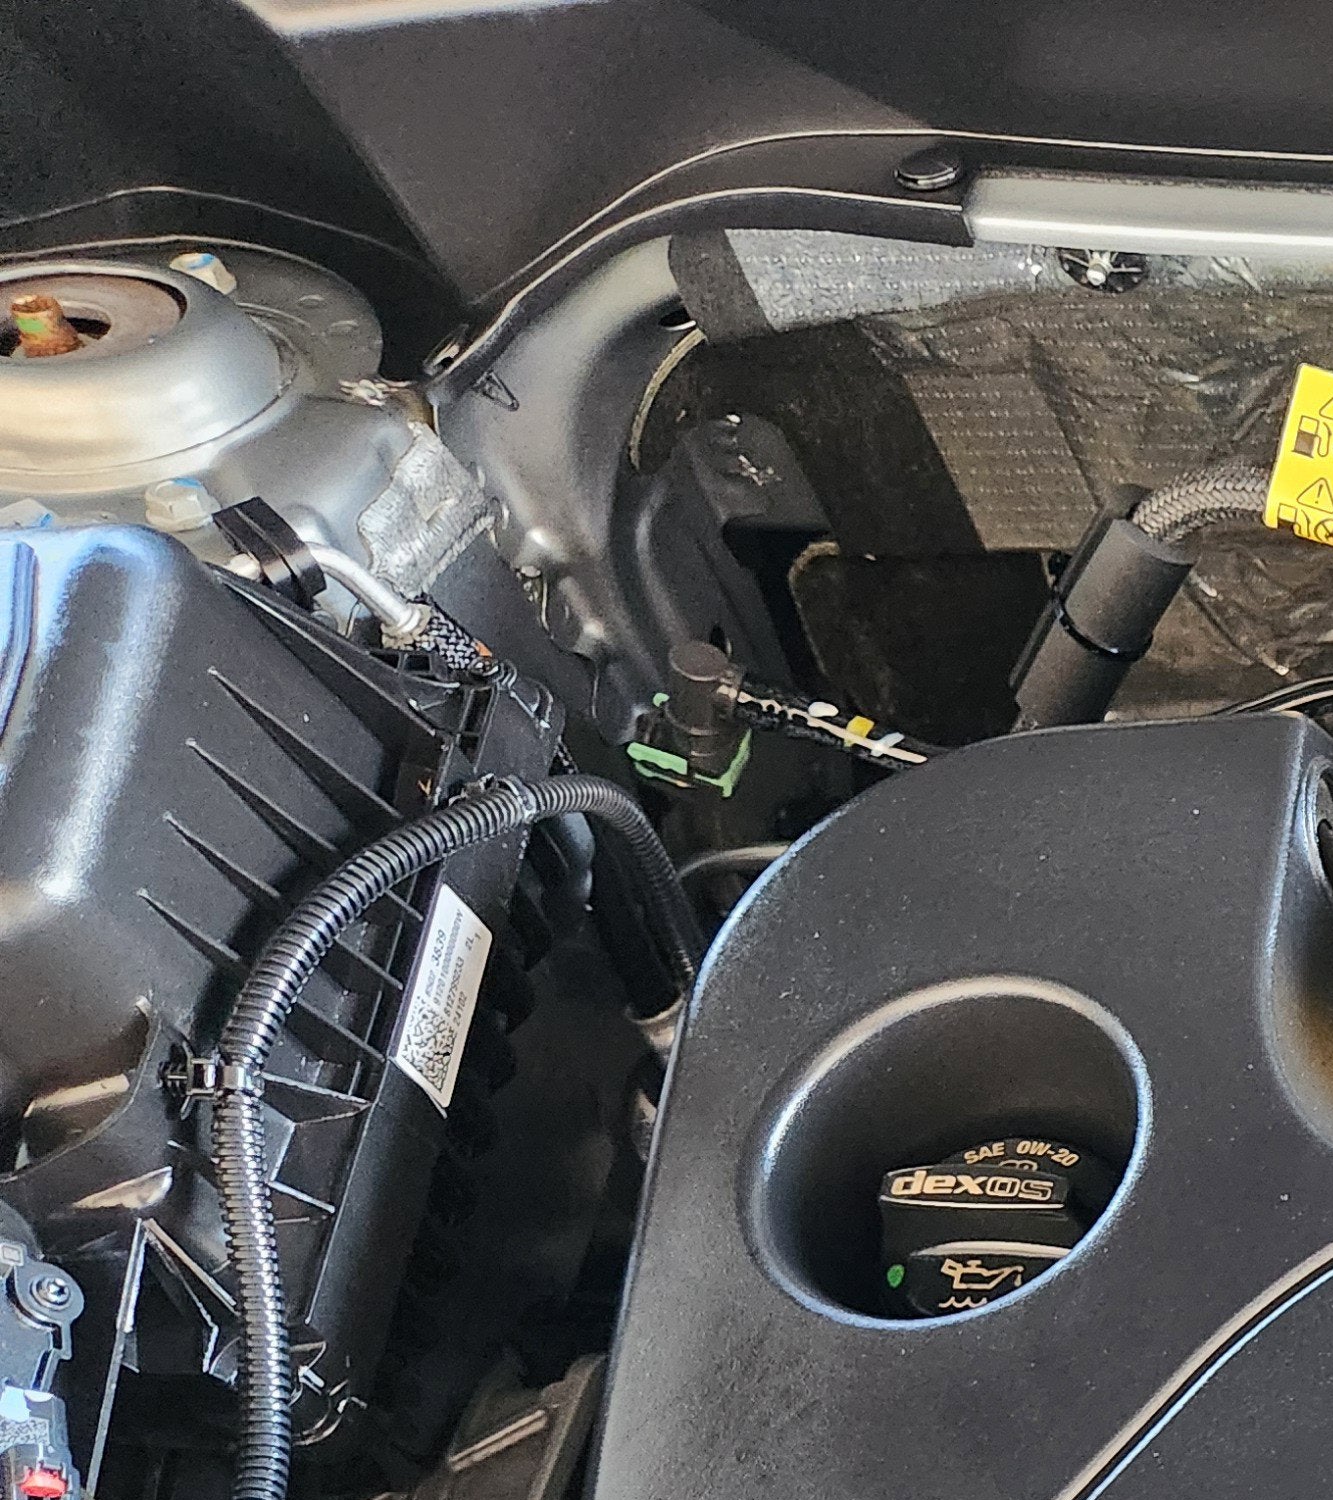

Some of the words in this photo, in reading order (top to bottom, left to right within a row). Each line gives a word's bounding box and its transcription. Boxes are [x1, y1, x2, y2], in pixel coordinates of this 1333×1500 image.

[964, 1142, 1005, 1165] SAE
[1016, 1140, 1080, 1167] 0W-20
[891, 1170, 1054, 1201] dexos
